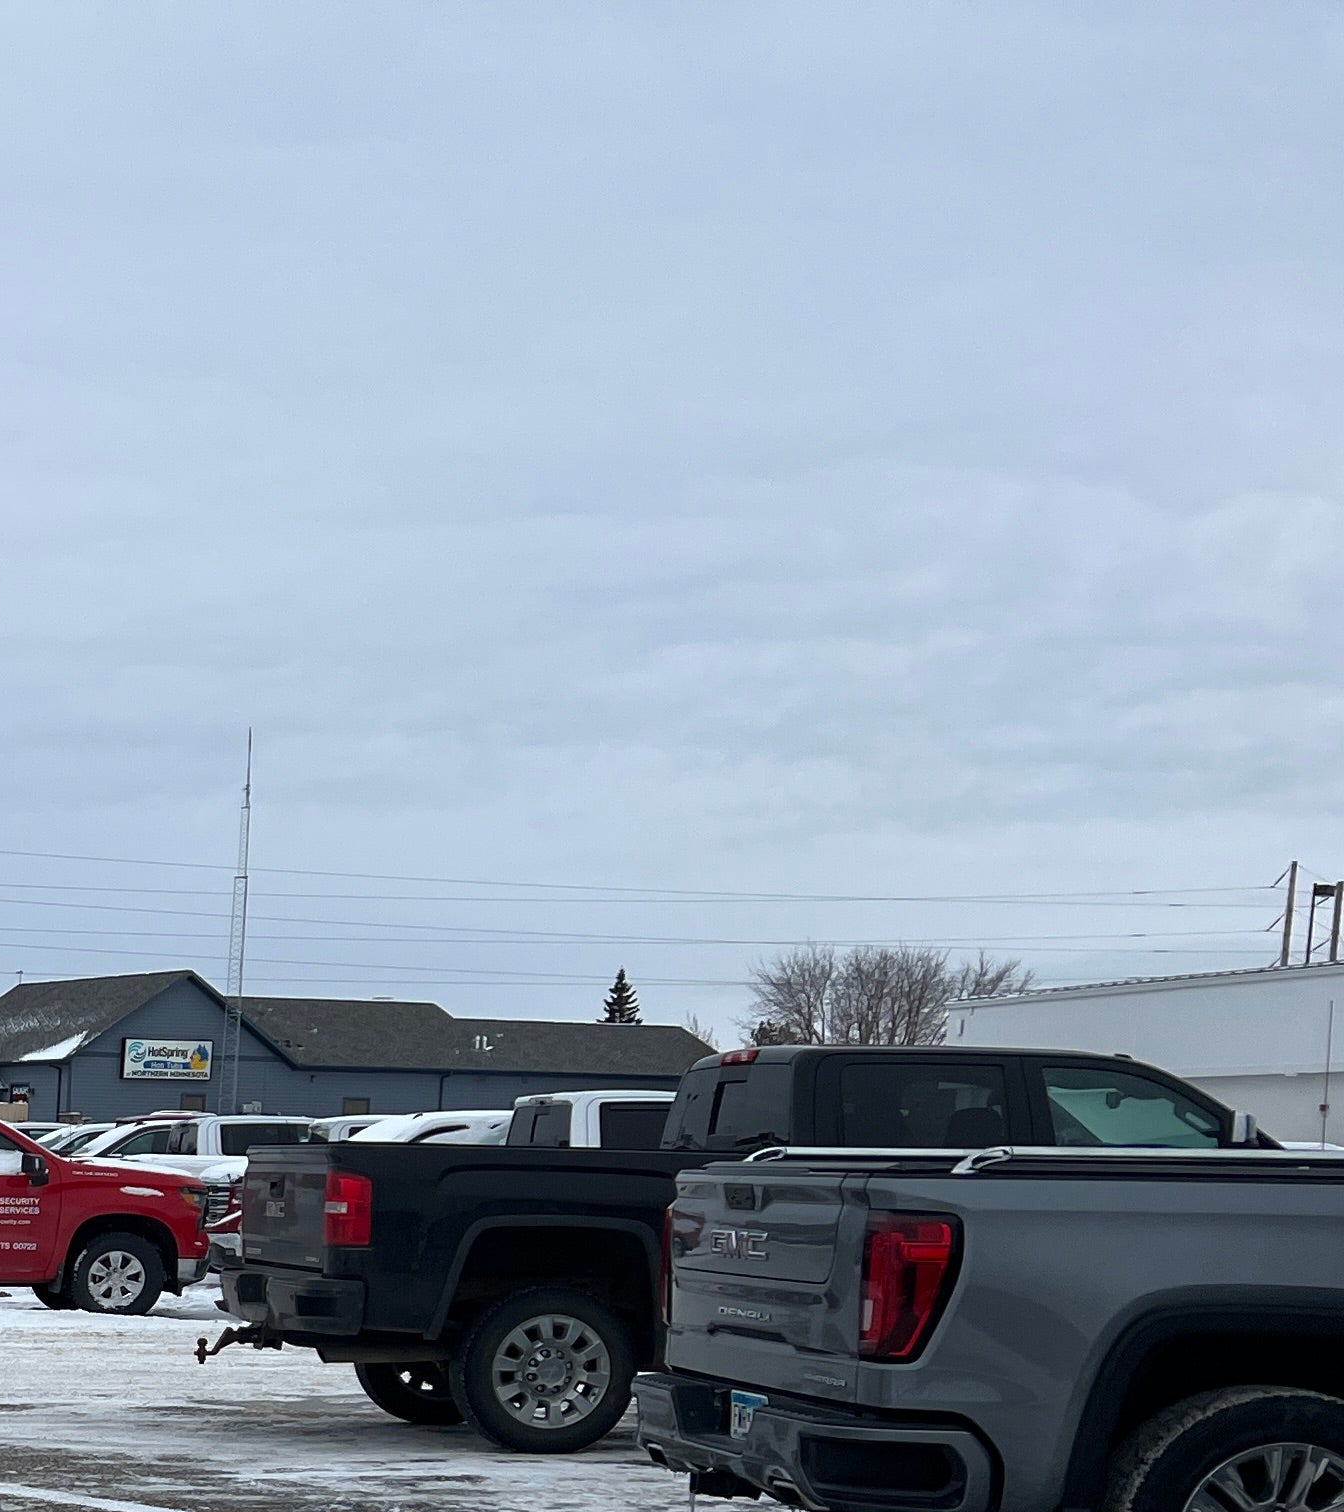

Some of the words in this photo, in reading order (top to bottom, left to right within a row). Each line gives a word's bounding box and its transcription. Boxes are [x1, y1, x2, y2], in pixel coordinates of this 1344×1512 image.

[148, 1046, 189, 1060] HotSpring
[131, 1070, 169, 1078] NORTHERN
[170, 1071, 209, 1079] MINNESOTA
[0, 1197, 40, 1205] SECURITY
[0, 1206, 40, 1215] SERVICES
[0, 1242, 10, 1250] TS
[711, 1229, 769, 1260] GMC
